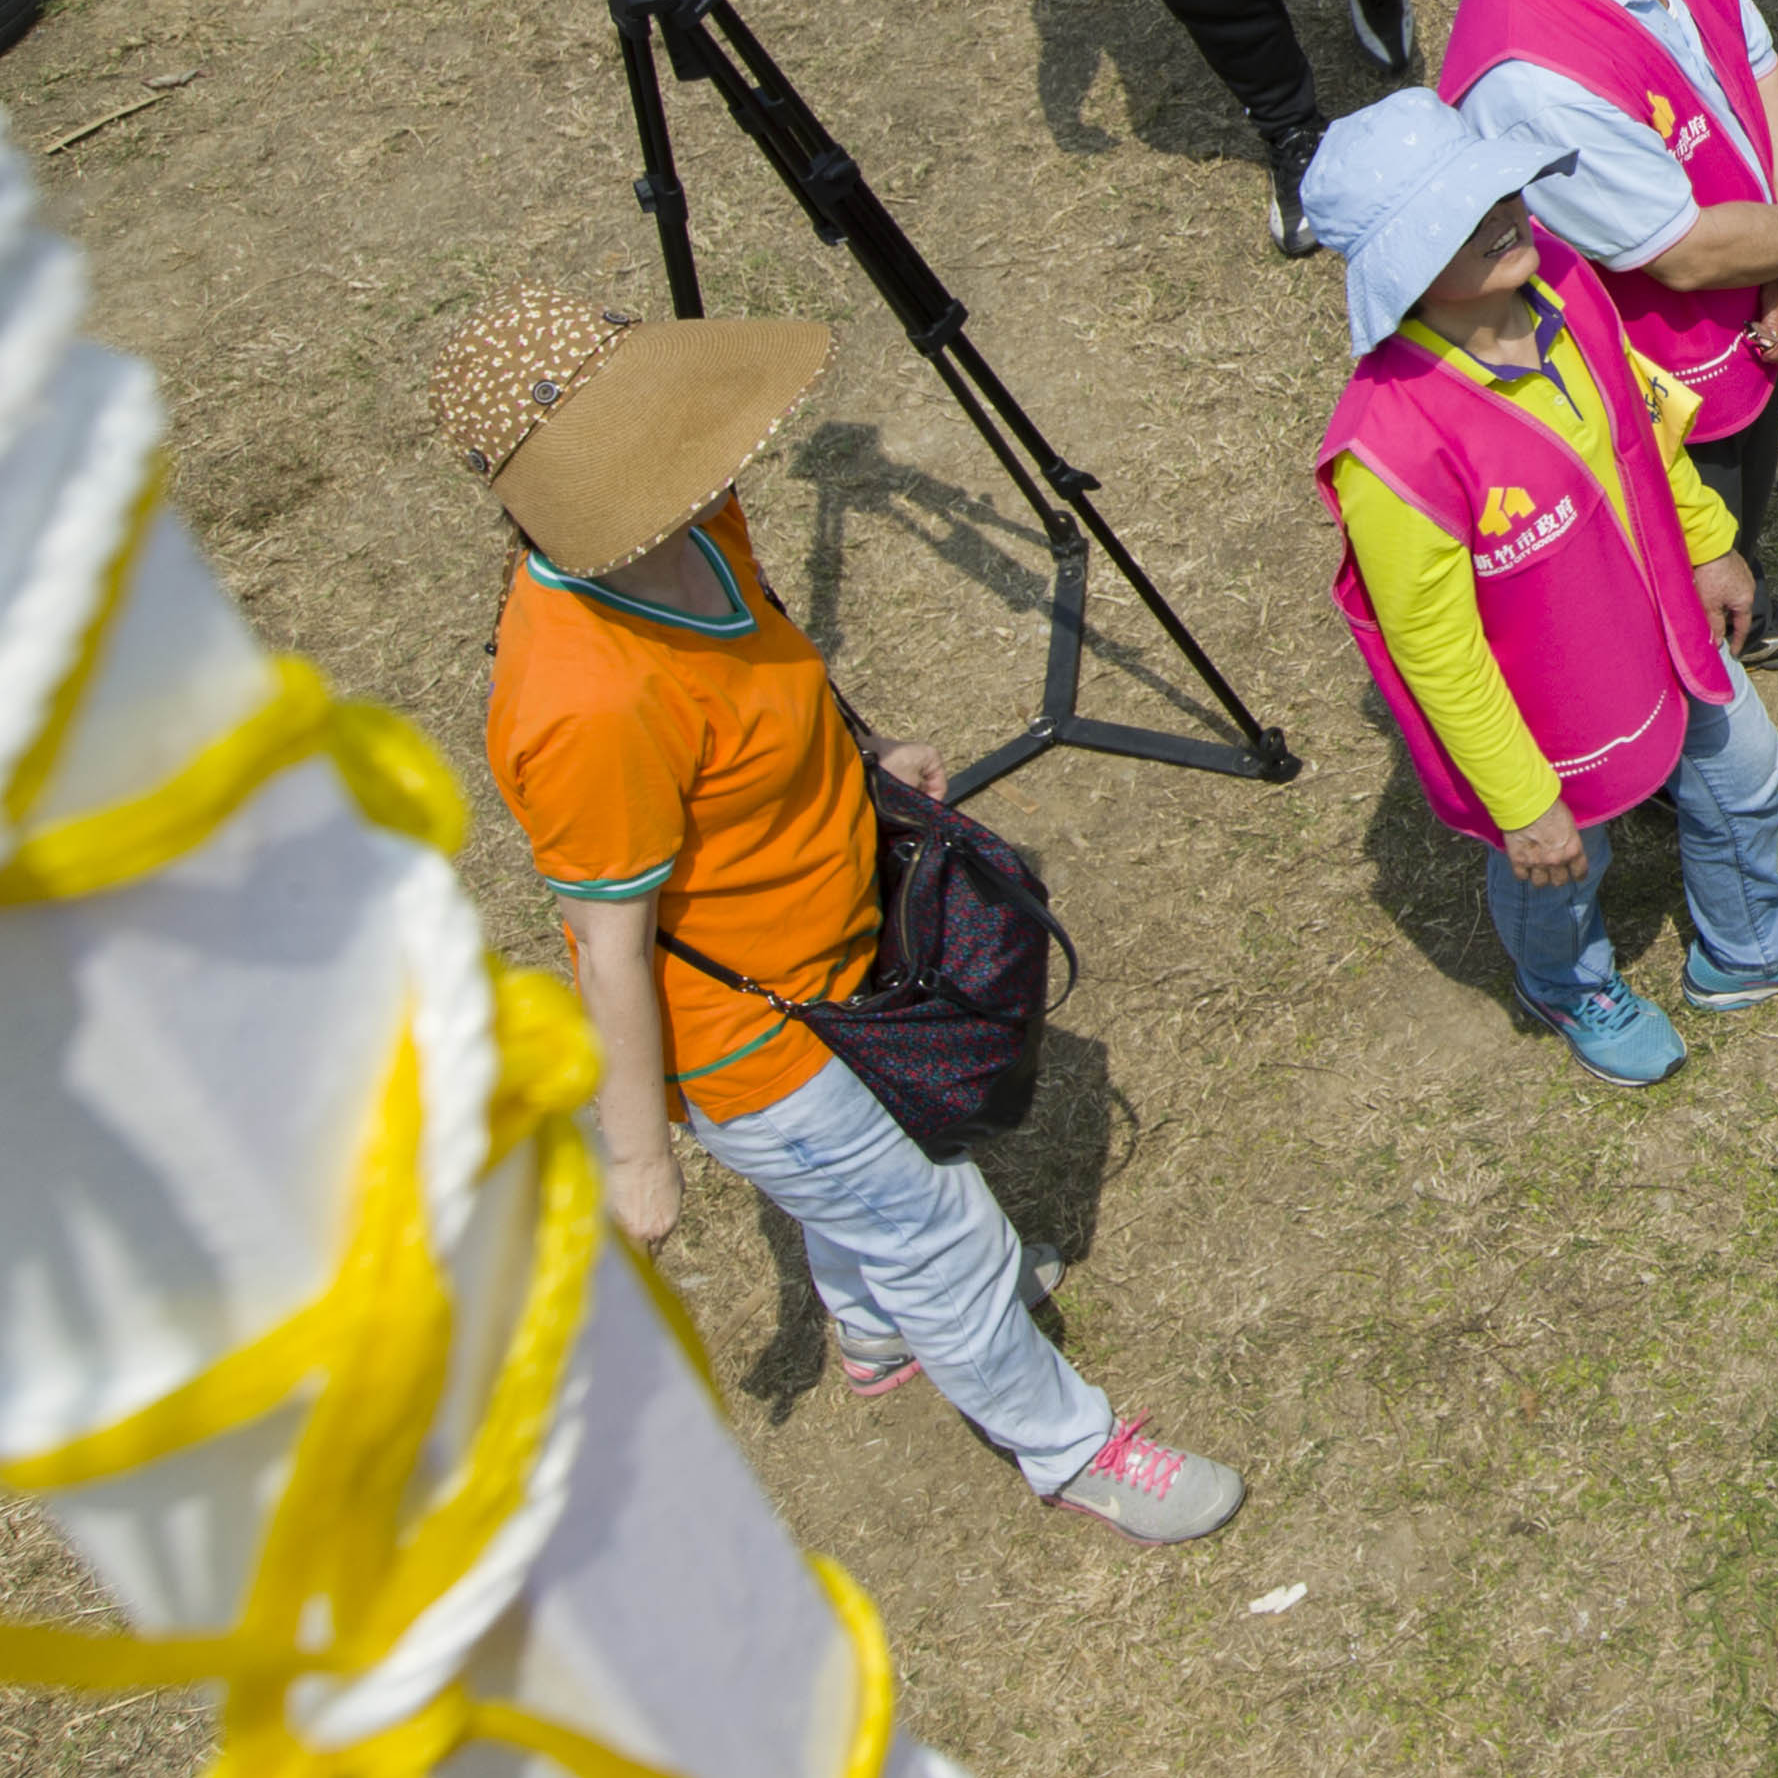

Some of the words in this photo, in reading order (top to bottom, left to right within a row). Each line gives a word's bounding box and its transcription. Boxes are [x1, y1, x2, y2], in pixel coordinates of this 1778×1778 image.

[1472, 494, 1575, 571] 新竹市政府
